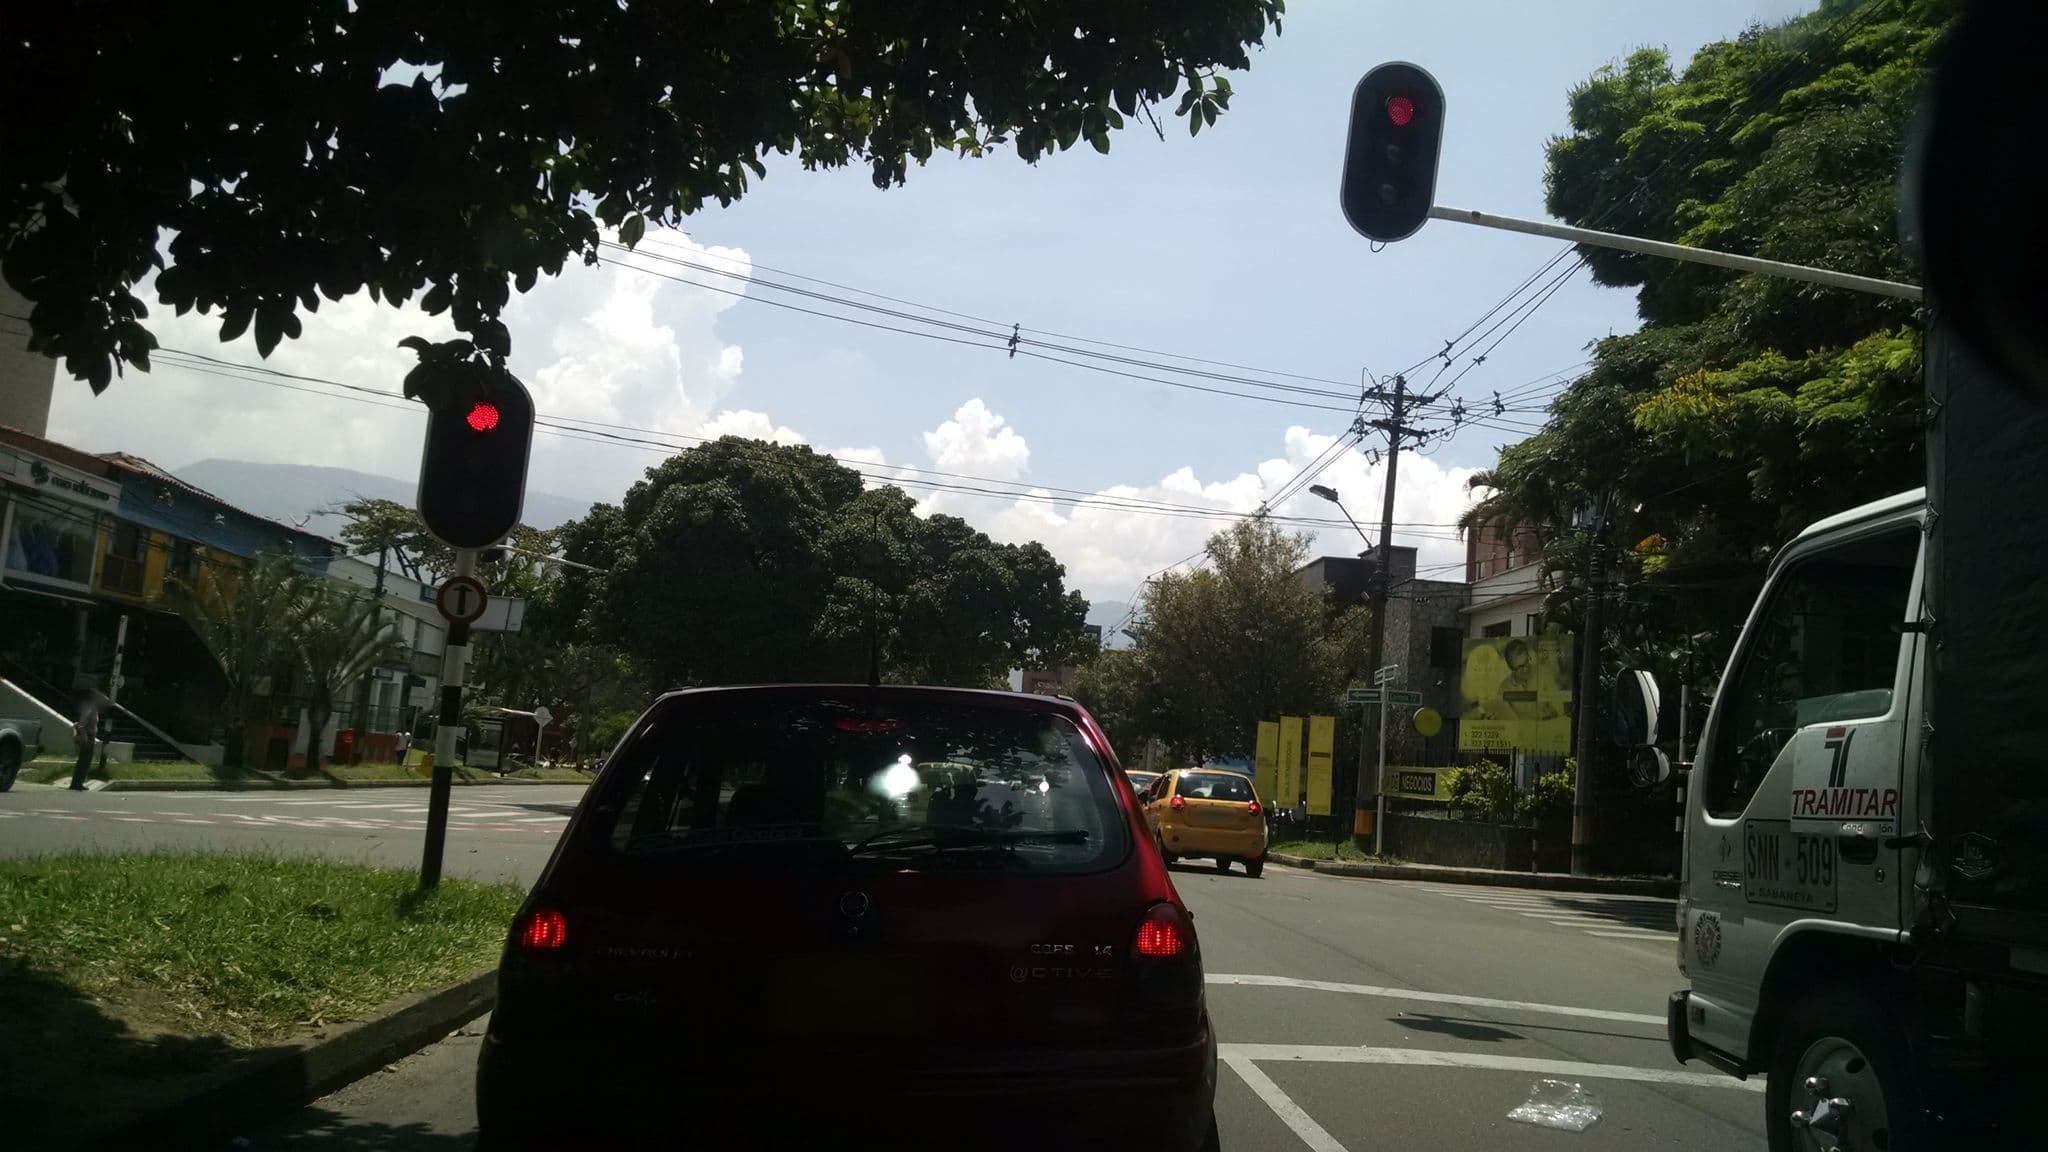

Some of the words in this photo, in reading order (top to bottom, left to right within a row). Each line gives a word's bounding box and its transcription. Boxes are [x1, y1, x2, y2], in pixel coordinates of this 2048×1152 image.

[1401, 774, 1433, 793] NEGOCIOS
[1791, 788, 1898, 816] TRAMITAR
[1841, 822, 1893, 834] Condión
[1747, 834, 1780, 881] SNN
[1796, 836, 1833, 887] 509
[1758, 887, 1814, 904] SABANETA
